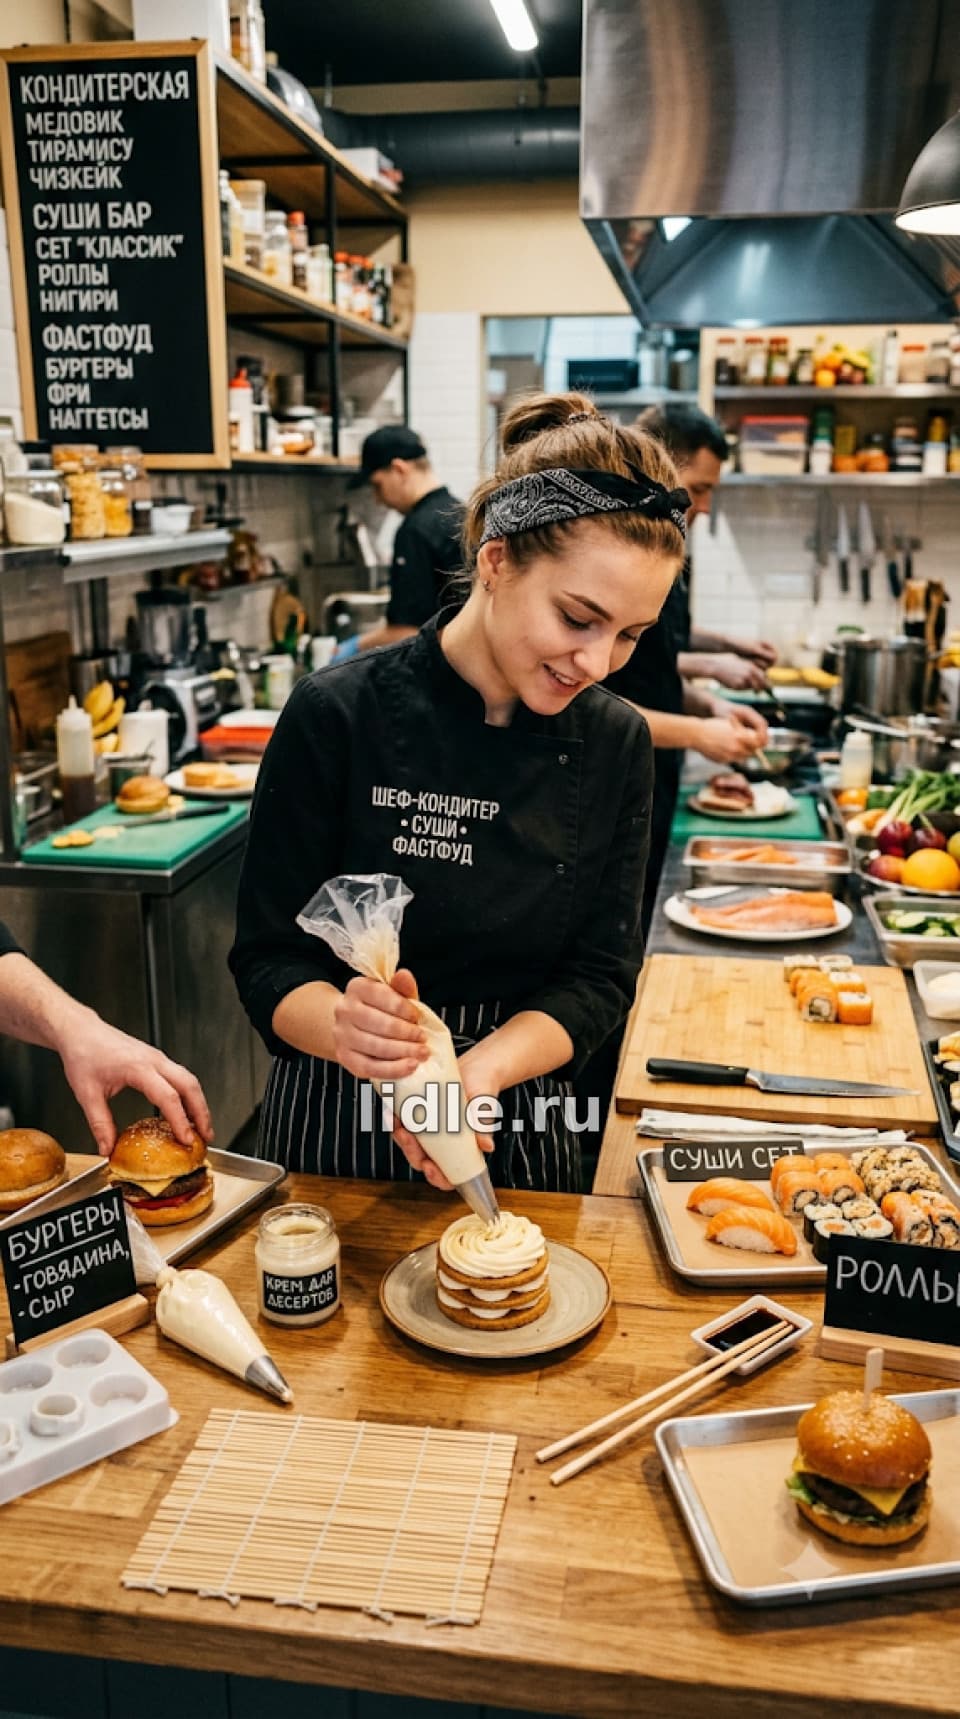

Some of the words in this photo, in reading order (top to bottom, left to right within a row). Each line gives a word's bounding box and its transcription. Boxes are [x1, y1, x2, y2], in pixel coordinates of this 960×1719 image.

[20, 70, 189, 106] КОНДИТЕРСКАЯ
[26, 110, 124, 136] МЕДОВИК
[27, 137, 134, 162] ТИРАМИСУ
[29, 161, 123, 190] ЧИЗКЕЙК
[33, 202, 101, 230] СУШИ
[107, 201, 152, 229] БАР
[36, 236, 72, 260] СЕТ
[38, 263, 109, 286] РОЛЛЫ
[39, 289, 119, 312] НИГИРИ
[42, 323, 154, 354] ФАСТФУД
[45, 357, 134, 380] БУРГЕРЫ
[46, 382, 91, 405] ФРИ
[48, 407, 149, 430] НАГГЕТСЫ
[371, 785, 500, 821] ШЕФ-КОНДИТЕР
[392, 835, 473, 867] ФАСТФУД
[669, 1147, 744, 1170] СУШИ
[7, 1196, 121, 1262] БУРГЕРЫ
[266, 1275, 304, 1293] КРЕМ
[308, 1270, 333, 1292] ДЛЯ
[836, 1255, 960, 1307] РОЛЛЫ
[267, 1287, 335, 1309] ДЕСЕРТОВ
